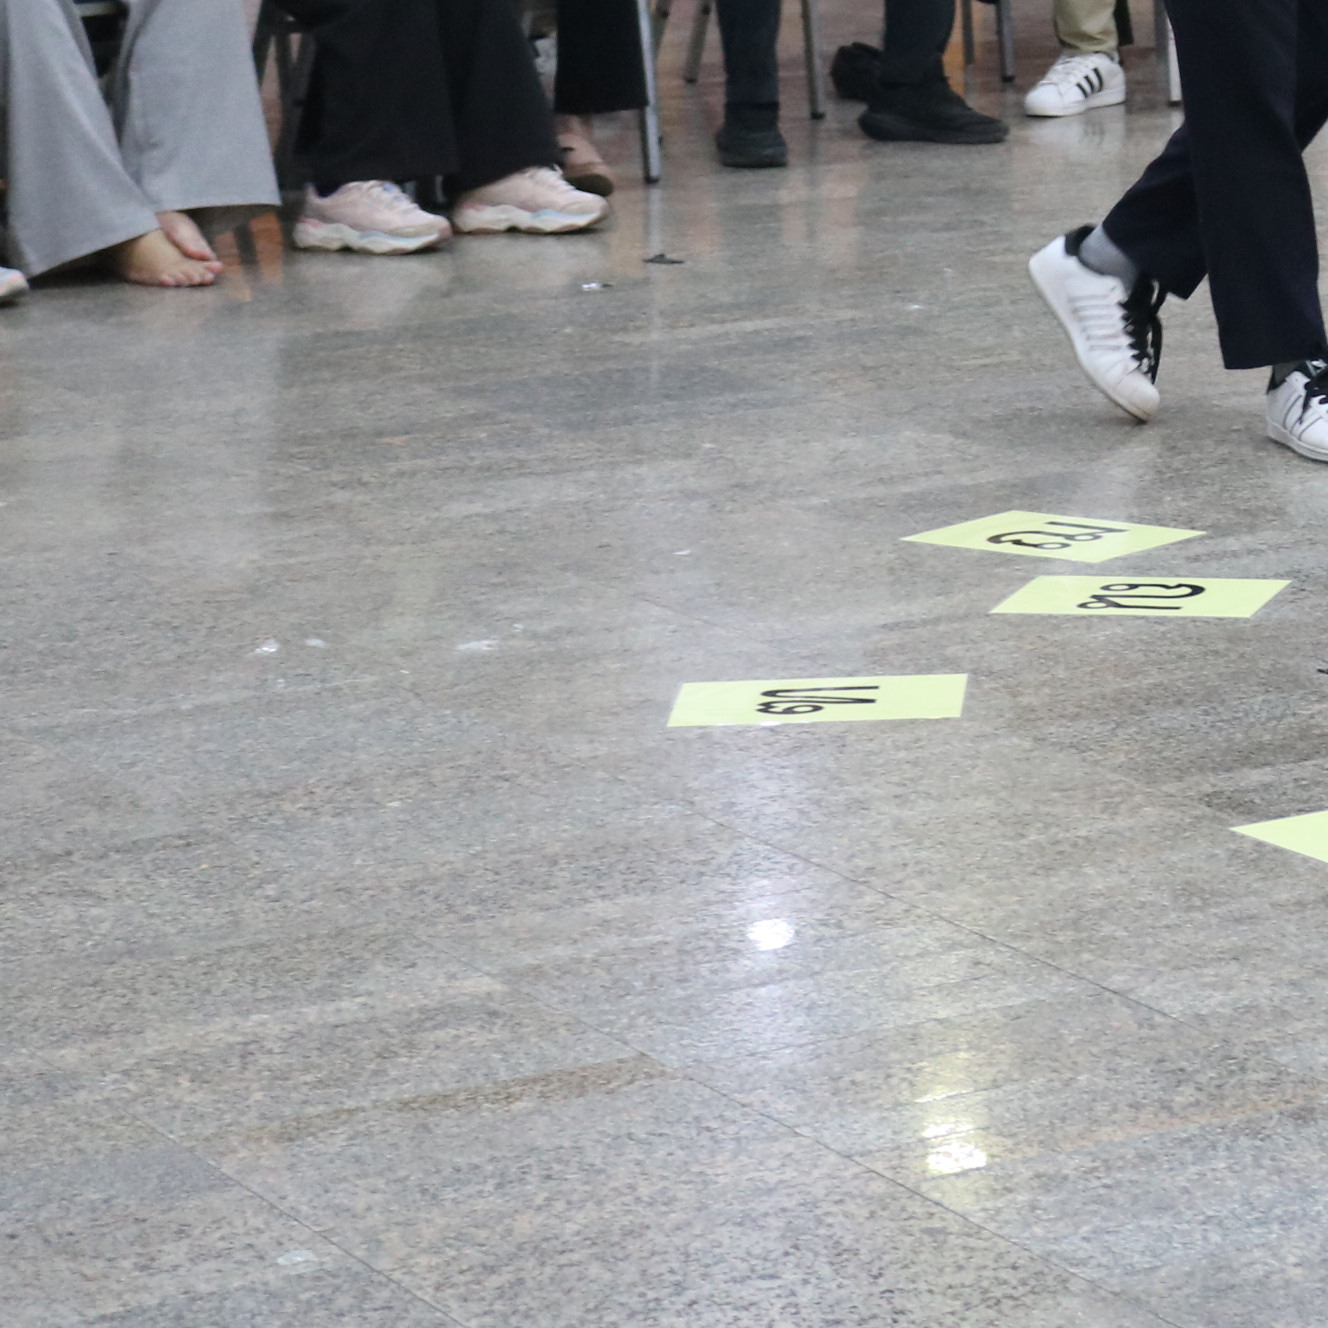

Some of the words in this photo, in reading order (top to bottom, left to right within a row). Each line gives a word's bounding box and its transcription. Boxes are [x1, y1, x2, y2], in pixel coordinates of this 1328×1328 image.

[986, 520, 1128, 550] ฌ
[1076, 582, 1207, 611] ณ
[755, 685, 880, 715] ฑ
